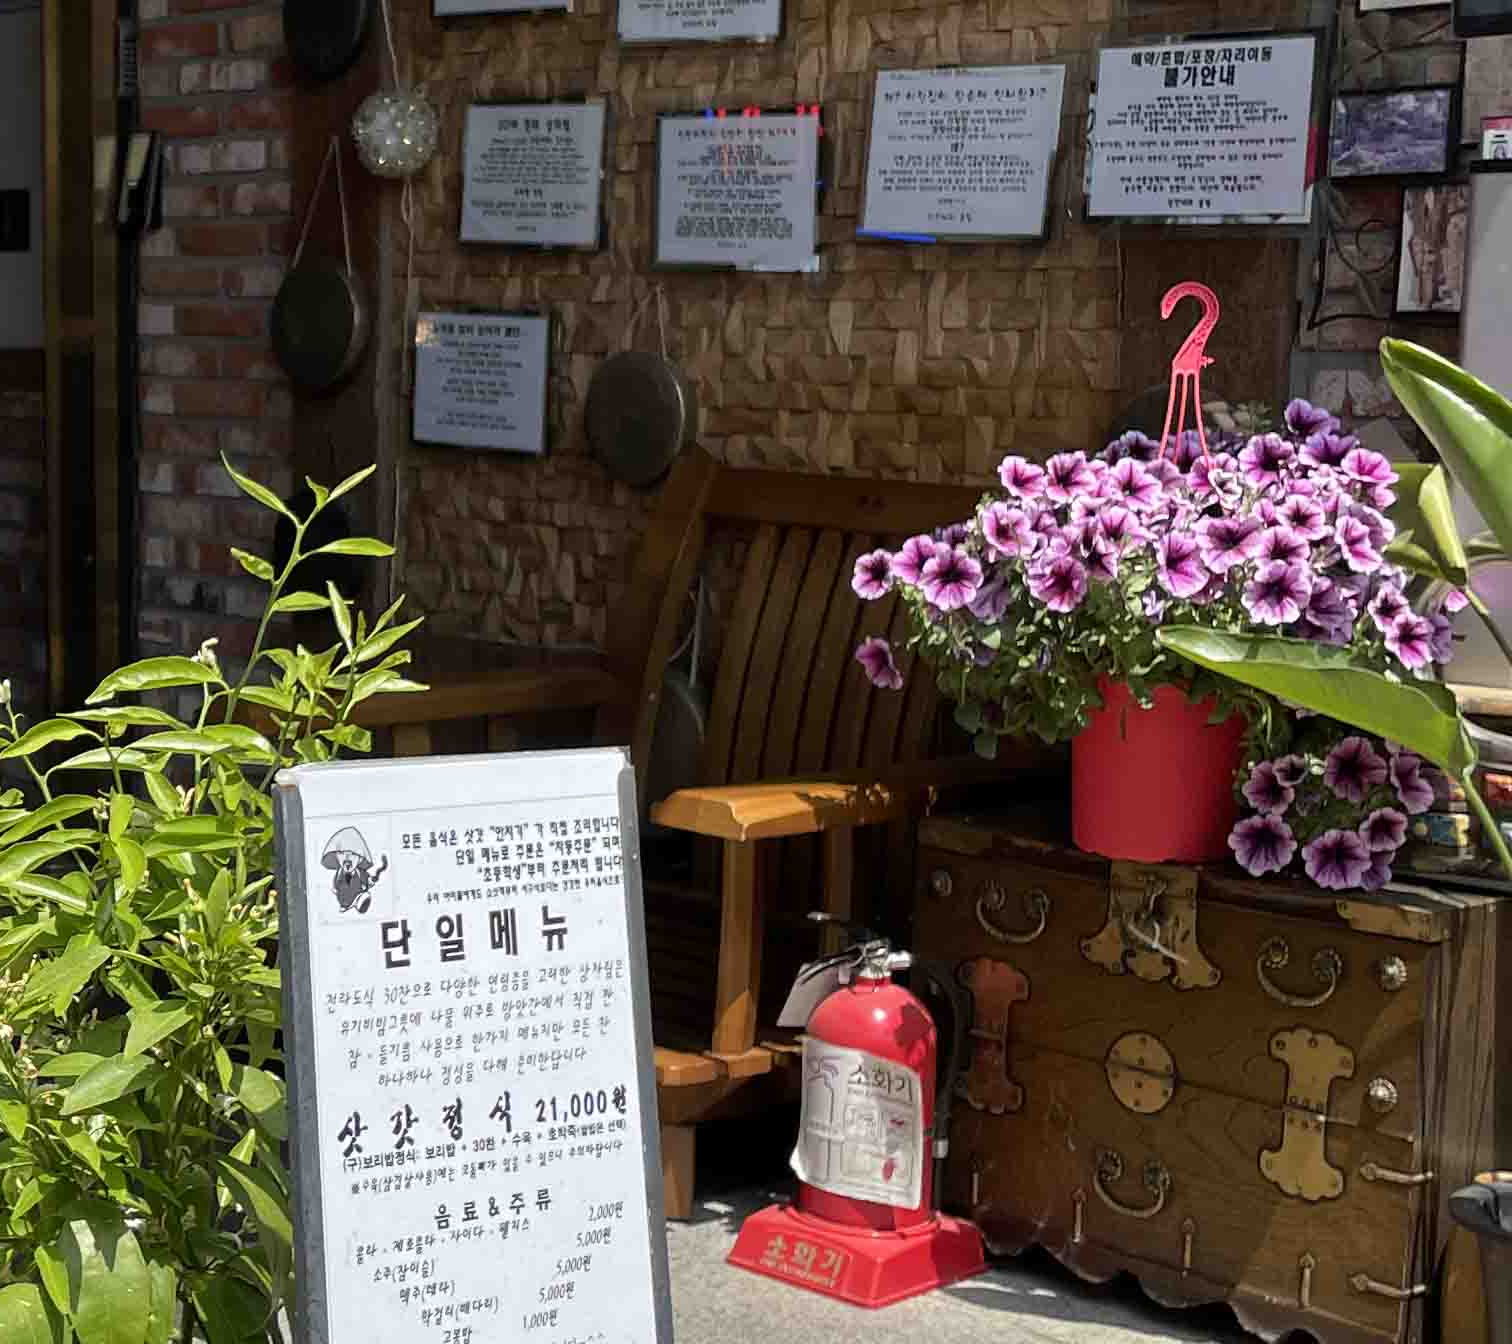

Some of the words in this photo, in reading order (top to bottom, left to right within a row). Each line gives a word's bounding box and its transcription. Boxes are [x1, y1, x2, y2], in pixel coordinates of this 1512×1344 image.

[1164, 64, 1236, 88] 불가안내
[402, 833, 421, 849] 모든
[429, 829, 458, 847] 음식은
[455, 848, 475, 866] 단일
[480, 845, 510, 864] 메뉴로
[516, 841, 544, 859] 주문은
[551, 857, 589, 875] 주문처리
[380, 905, 569, 969] 단일메뉴
[326, 986, 375, 1015] 전라도식
[440, 977, 480, 999] 다양한
[537, 966, 571, 985] 고려한
[421, 1034, 464, 1058] 사용으로
[377, 1069, 432, 1087] 하나하나
[337, 1090, 514, 1157] 삿갓정식
[535, 1084, 628, 1124] 21,000원
[424, 1141, 456, 1161] 보리밥
[487, 1196, 501, 1217] &
[450, 1224, 486, 1244] 사이다
